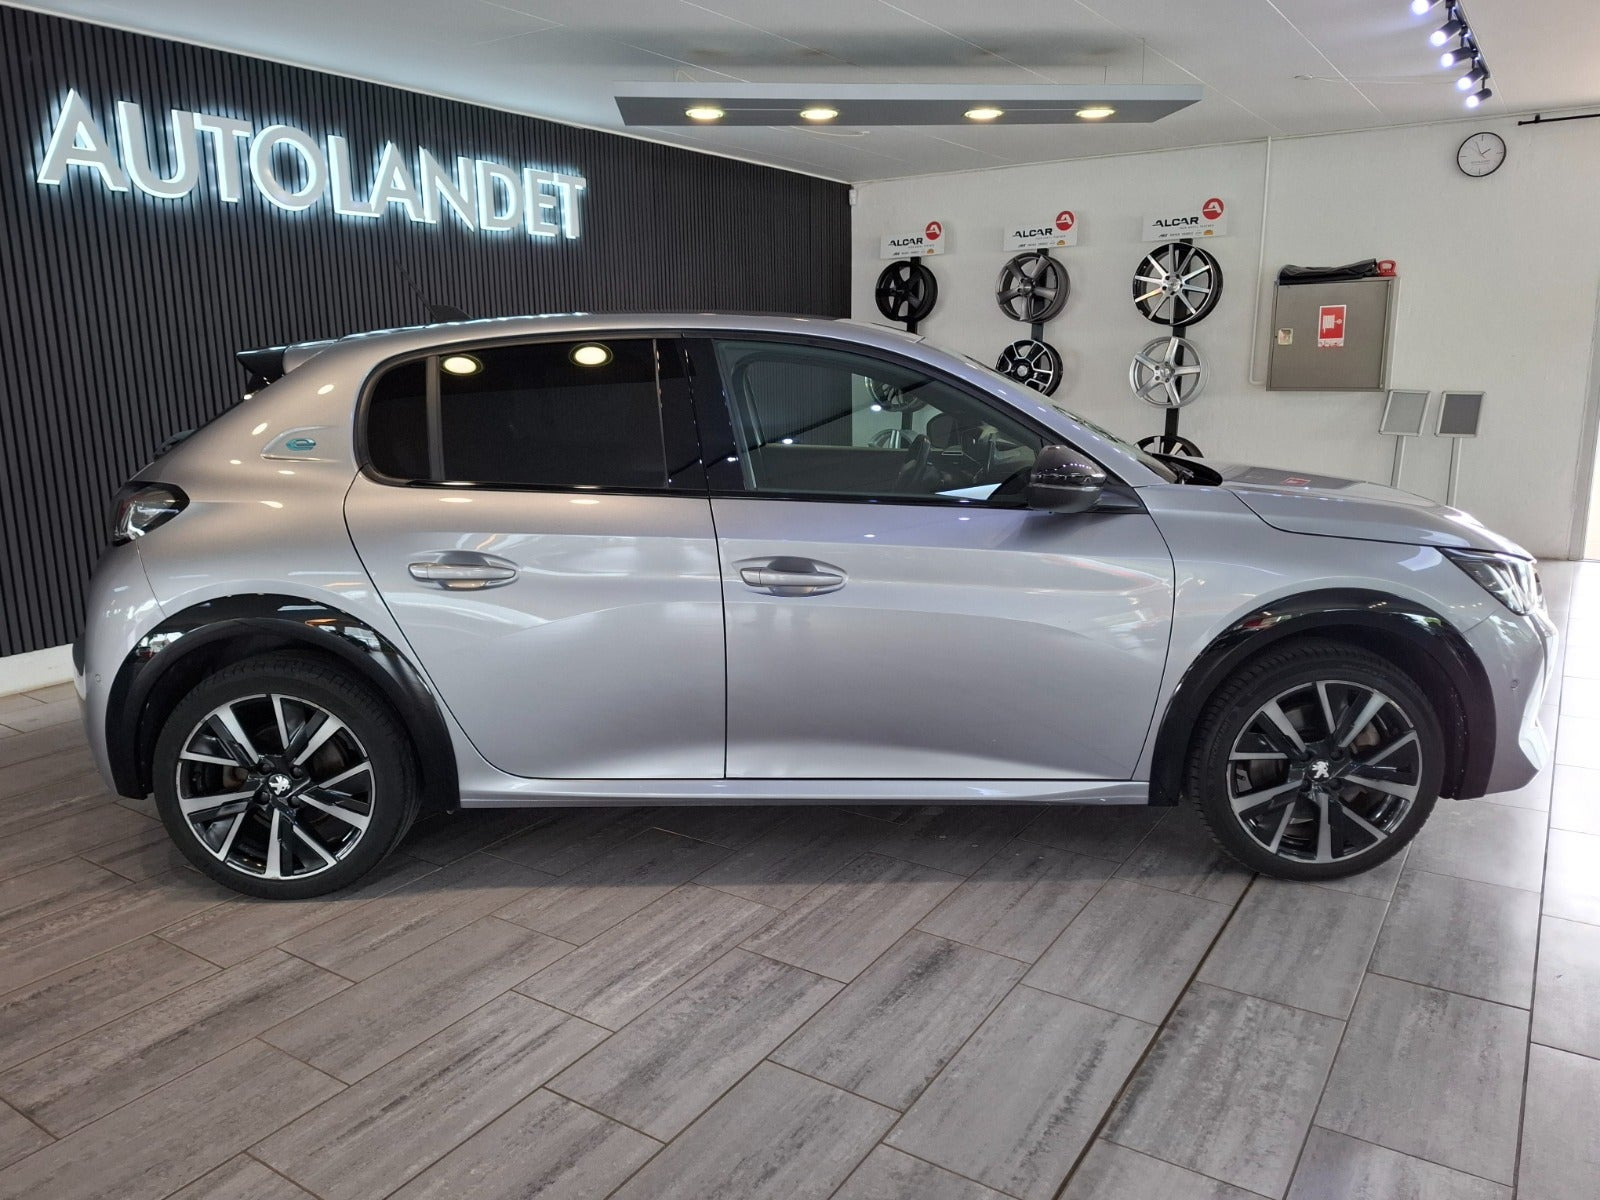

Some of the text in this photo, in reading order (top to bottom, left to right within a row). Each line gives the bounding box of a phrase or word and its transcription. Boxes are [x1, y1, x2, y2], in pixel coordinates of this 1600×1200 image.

[37, 88, 587, 240] AUTOLANDET
[1152, 217, 1199, 227] ALCAR
[1013, 228, 1053, 238] ALCAR
[888, 237, 924, 247] ALCAR
